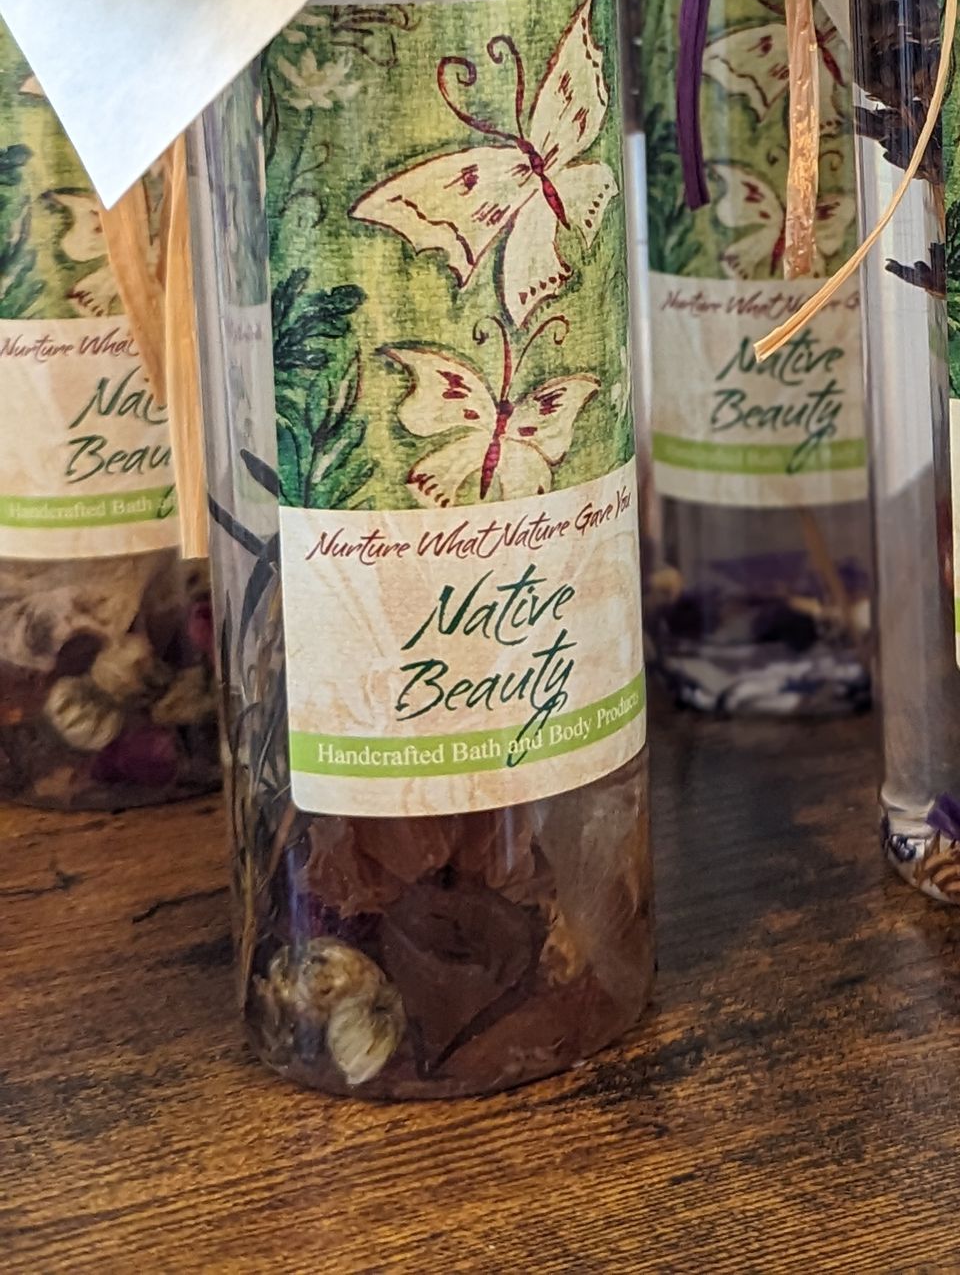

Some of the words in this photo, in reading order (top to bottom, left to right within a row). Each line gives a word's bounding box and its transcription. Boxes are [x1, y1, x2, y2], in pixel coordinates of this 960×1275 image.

[0, 334, 73, 363] Nurture
[715, 327, 846, 386] Native
[711, 378, 845, 474] Beauty
[9, 501, 106, 520] Handcrafted
[113, 495, 152, 515] Bath
[305, 528, 411, 565] Nurture
[417, 520, 501, 558] What
[499, 512, 569, 550] Nature
[574, 502, 613, 535] Gave
[615, 485, 632, 519] You
[401, 563, 575, 650] Native
[395, 629, 577, 768] Beauty
[318, 743, 444, 767] Handcrafted
[453, 738, 501, 762] Bath
[508, 730, 543, 754] and
[549, 715, 593, 745] Body
